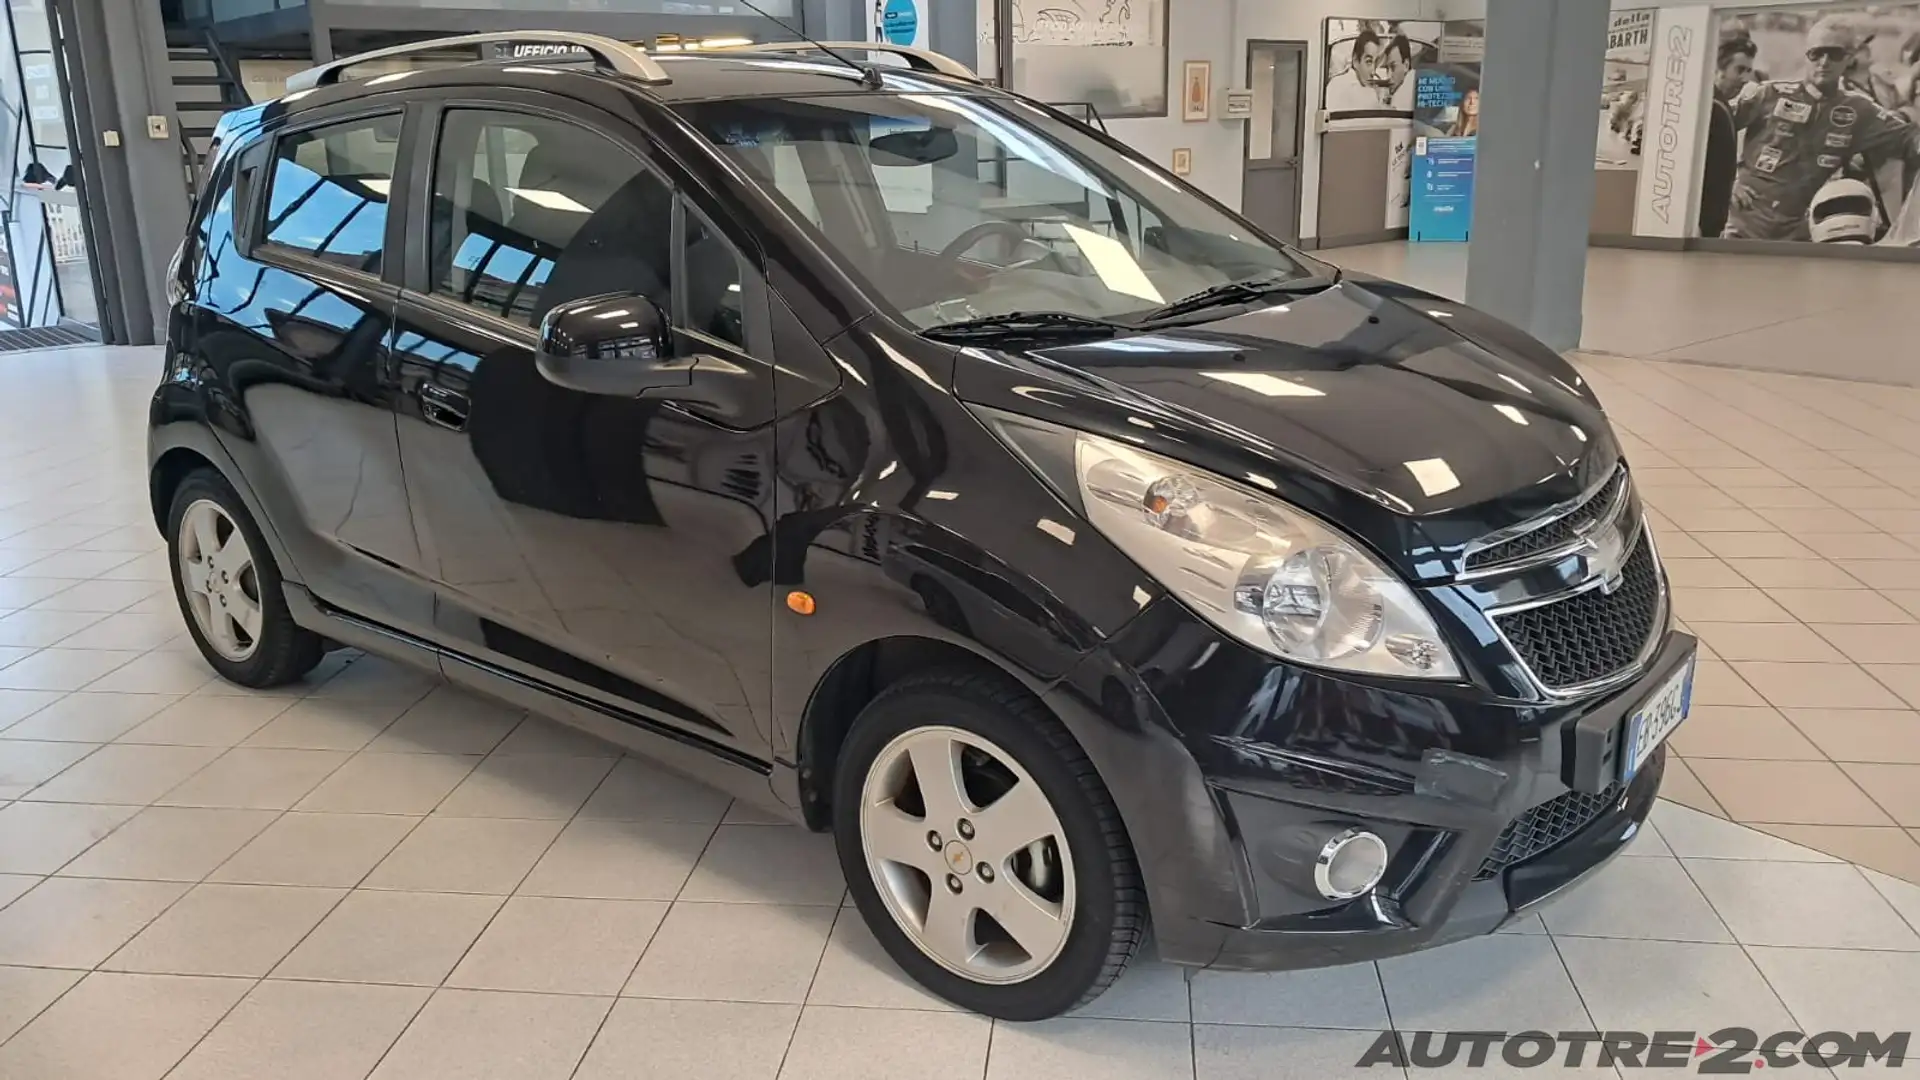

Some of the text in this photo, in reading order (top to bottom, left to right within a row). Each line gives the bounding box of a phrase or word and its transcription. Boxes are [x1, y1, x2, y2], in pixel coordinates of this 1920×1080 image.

[1613, 13, 1650, 27] della
[1609, 29, 1648, 49] BARTH
[513, 44, 568, 58] UFFICIO
[1652, 25, 1692, 224] AUTOTRE2
